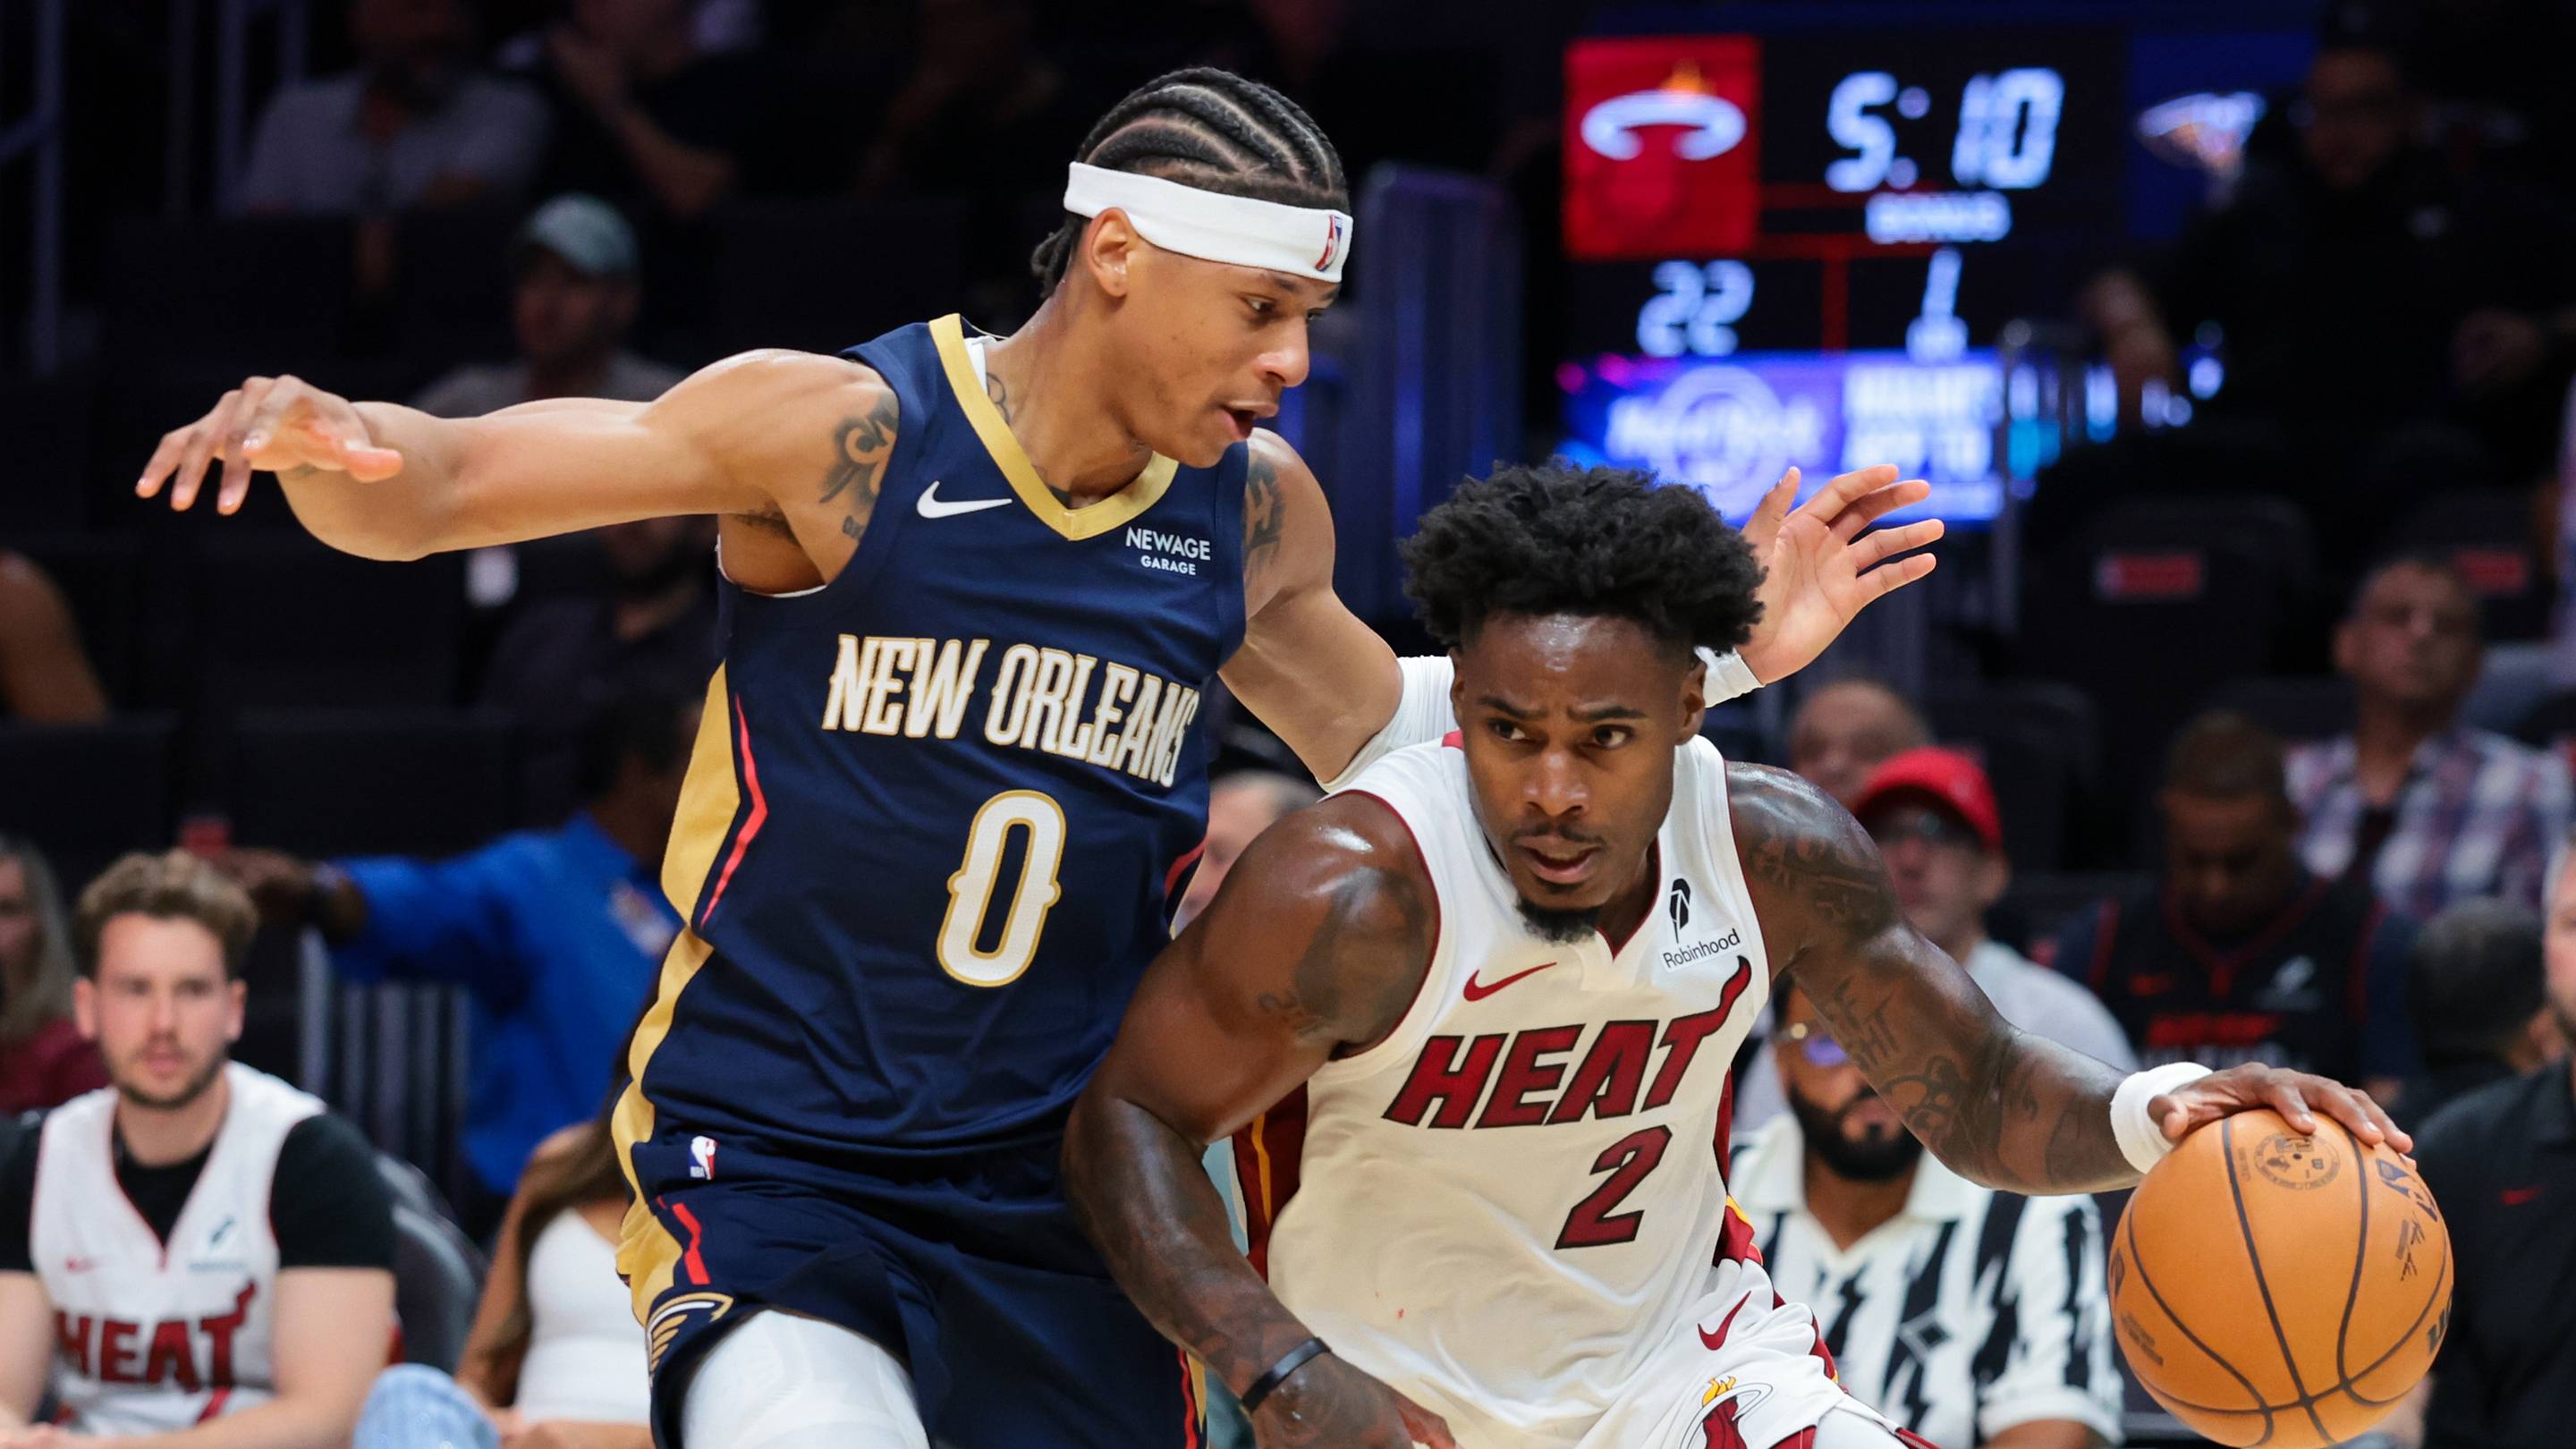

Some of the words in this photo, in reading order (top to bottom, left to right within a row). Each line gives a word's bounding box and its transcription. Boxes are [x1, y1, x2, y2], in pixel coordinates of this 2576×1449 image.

[1638, 260, 1753, 356] 22
[1126, 526, 1211, 561] NEWAGE
[1140, 555, 1196, 575] GARAGE
[822, 634, 989, 739] NEW
[985, 644, 1199, 788] ORLEANS
[936, 790, 1066, 987] 0
[1663, 928, 1741, 968] Robinhood
[1381, 955, 1752, 1130] HEAT
[1554, 1124, 1673, 1250] 2
[55, 1279, 257, 1393] HEAT
